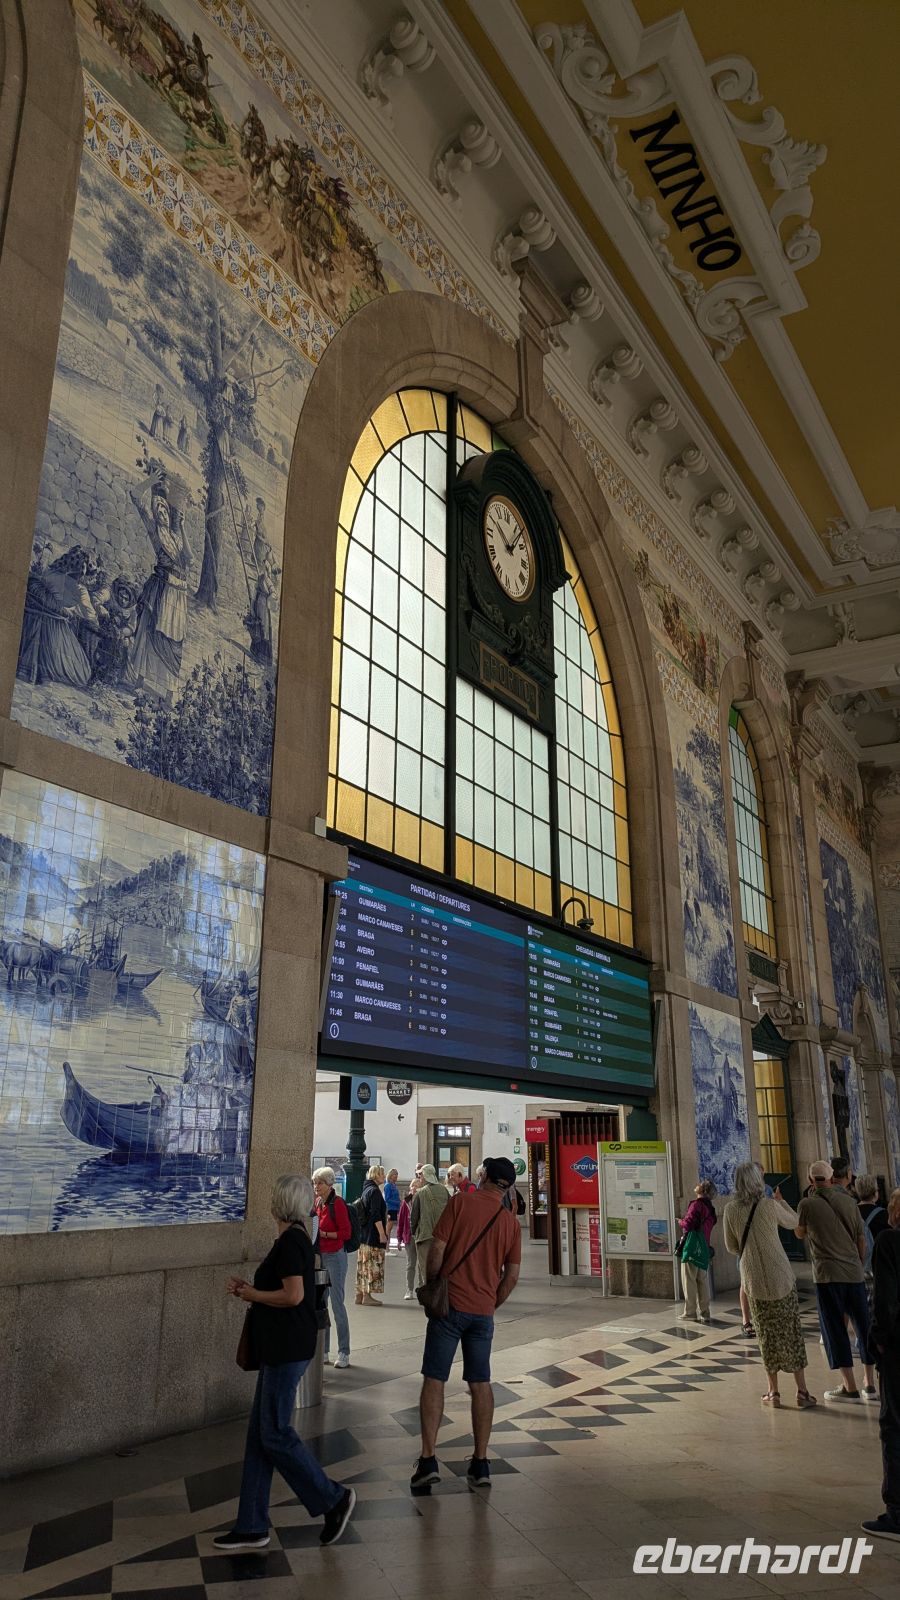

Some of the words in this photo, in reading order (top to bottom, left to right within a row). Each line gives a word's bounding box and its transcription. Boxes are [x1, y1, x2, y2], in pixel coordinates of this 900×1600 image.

[630, 110, 742, 272] MINHO
[410, 884, 436, 900] PARTIDAS
[439, 895, 471, 912] DEPARTURES
[358, 913, 375, 924] MARCO
[358, 929, 374, 940] BRAGA
[335, 940, 345, 948] 0:55
[357, 946, 375, 956] AVEIRO
[356, 962, 379, 973] PENAFIEL
[331, 973, 344, 982] 11:25
[330, 990, 343, 999] 11:30
[355, 995, 372, 1005] MARCO
[374, 999, 401, 1010] CANAVESES
[330, 1008, 342, 1016] 11:45
[354, 1012, 372, 1021] BRAGA
